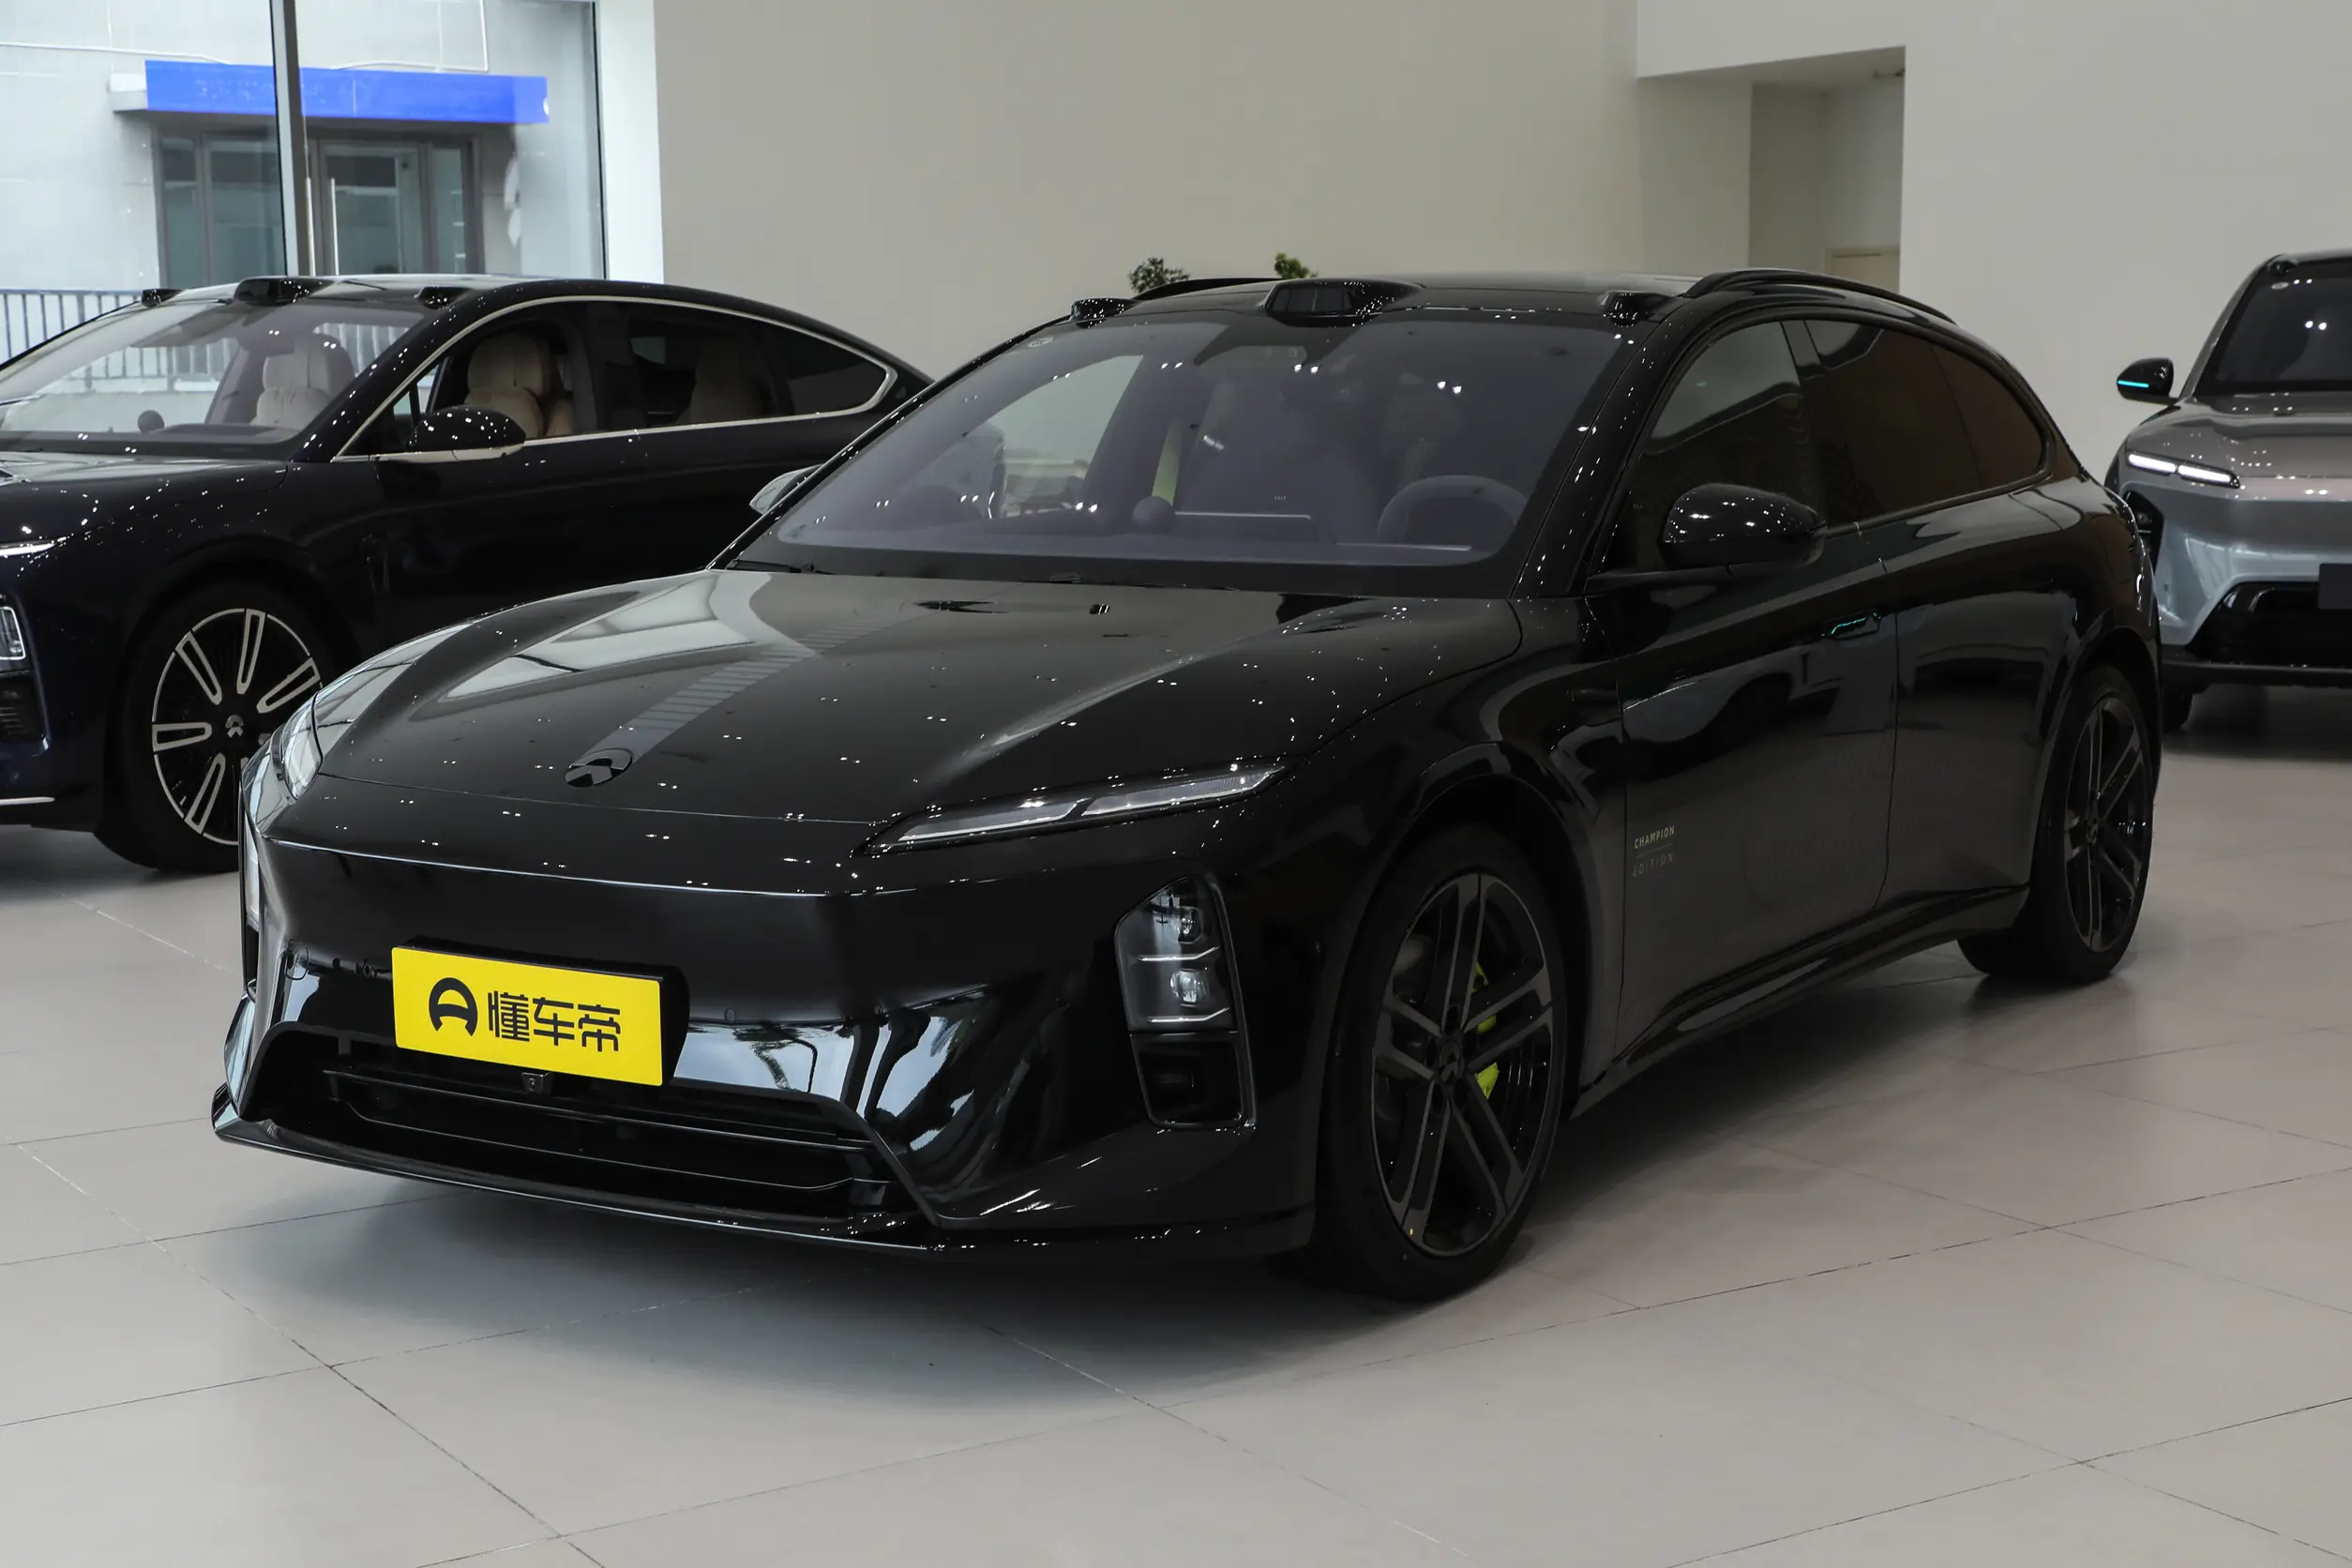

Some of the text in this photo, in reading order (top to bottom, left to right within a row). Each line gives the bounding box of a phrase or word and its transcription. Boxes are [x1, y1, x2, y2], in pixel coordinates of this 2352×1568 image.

[1634, 825, 1675, 849] CHAMPION
[1633, 852, 1673, 877] EDITION
[487, 990, 621, 1052] 懂车帝
